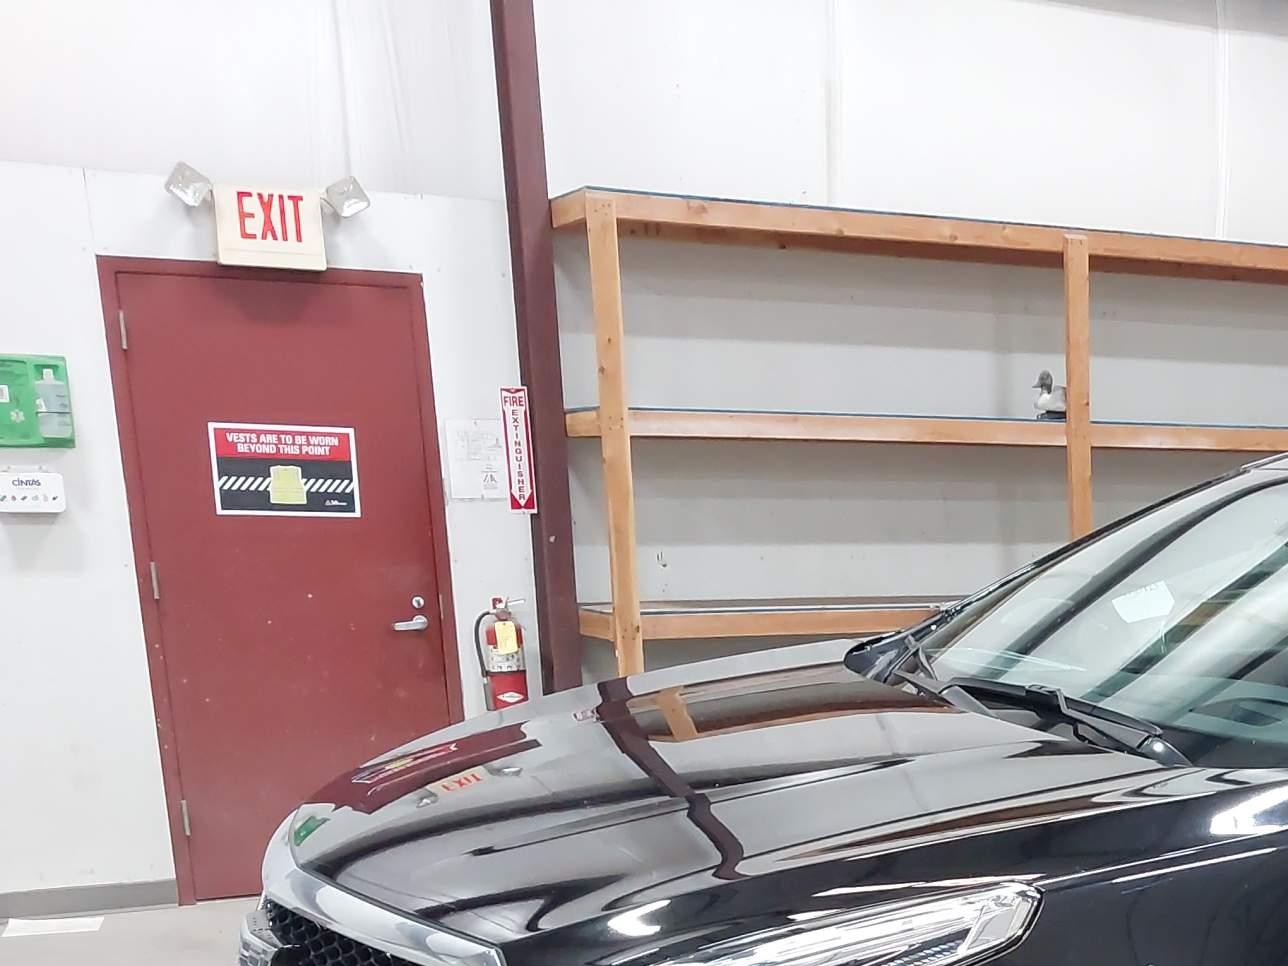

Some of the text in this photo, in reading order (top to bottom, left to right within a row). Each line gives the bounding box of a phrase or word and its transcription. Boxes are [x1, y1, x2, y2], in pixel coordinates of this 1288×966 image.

[237, 191, 303, 243] EXIT
[503, 396, 524, 407] FIRE
[226, 432, 339, 446] VESTS ARE TO BE WORN
[237, 443, 331, 455] BEYOND THIS POINT
[511, 409, 526, 500] EXTINGUISHER
